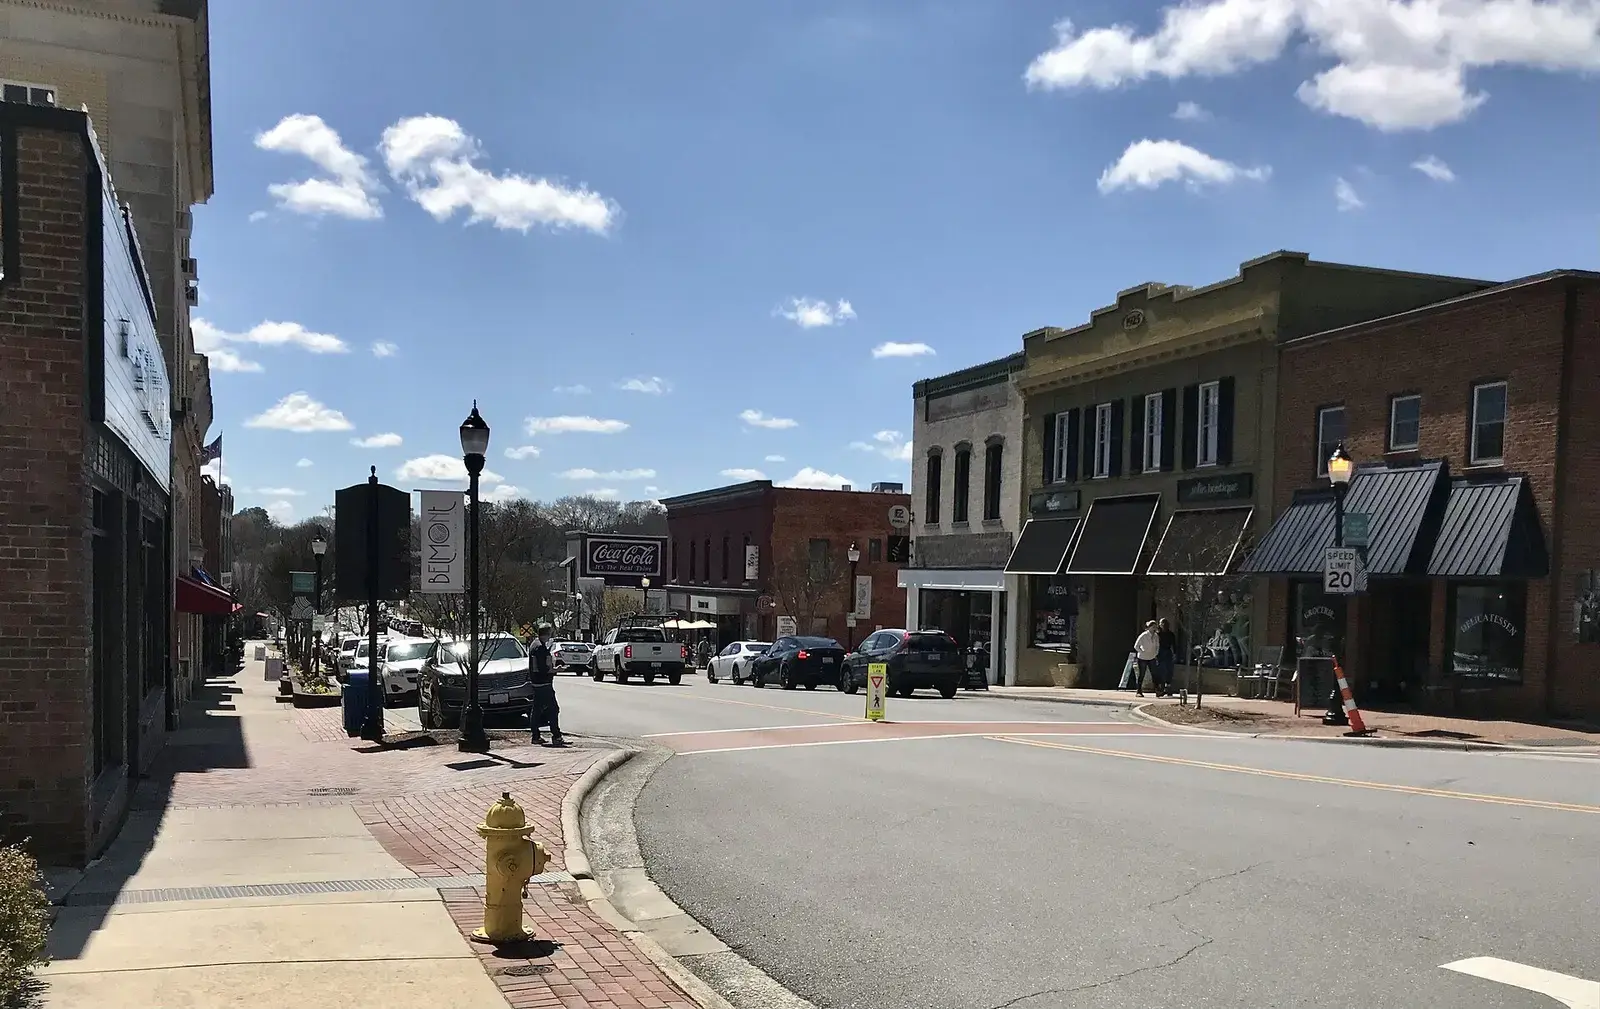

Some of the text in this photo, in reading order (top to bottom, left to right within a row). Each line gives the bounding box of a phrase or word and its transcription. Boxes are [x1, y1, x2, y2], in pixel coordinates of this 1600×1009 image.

[428, 501, 457, 583] BELMONT
[593, 544, 656, 565] Coca-Cola
[1327, 552, 1354, 561] SPEED
[1330, 562, 1351, 570] LIMIT
[1328, 571, 1352, 588] 20
[1047, 585, 1068, 595] AVEDA
[1047, 615, 1065, 625] ReGen
[1460, 613, 1518, 637] DELICATESSEN
